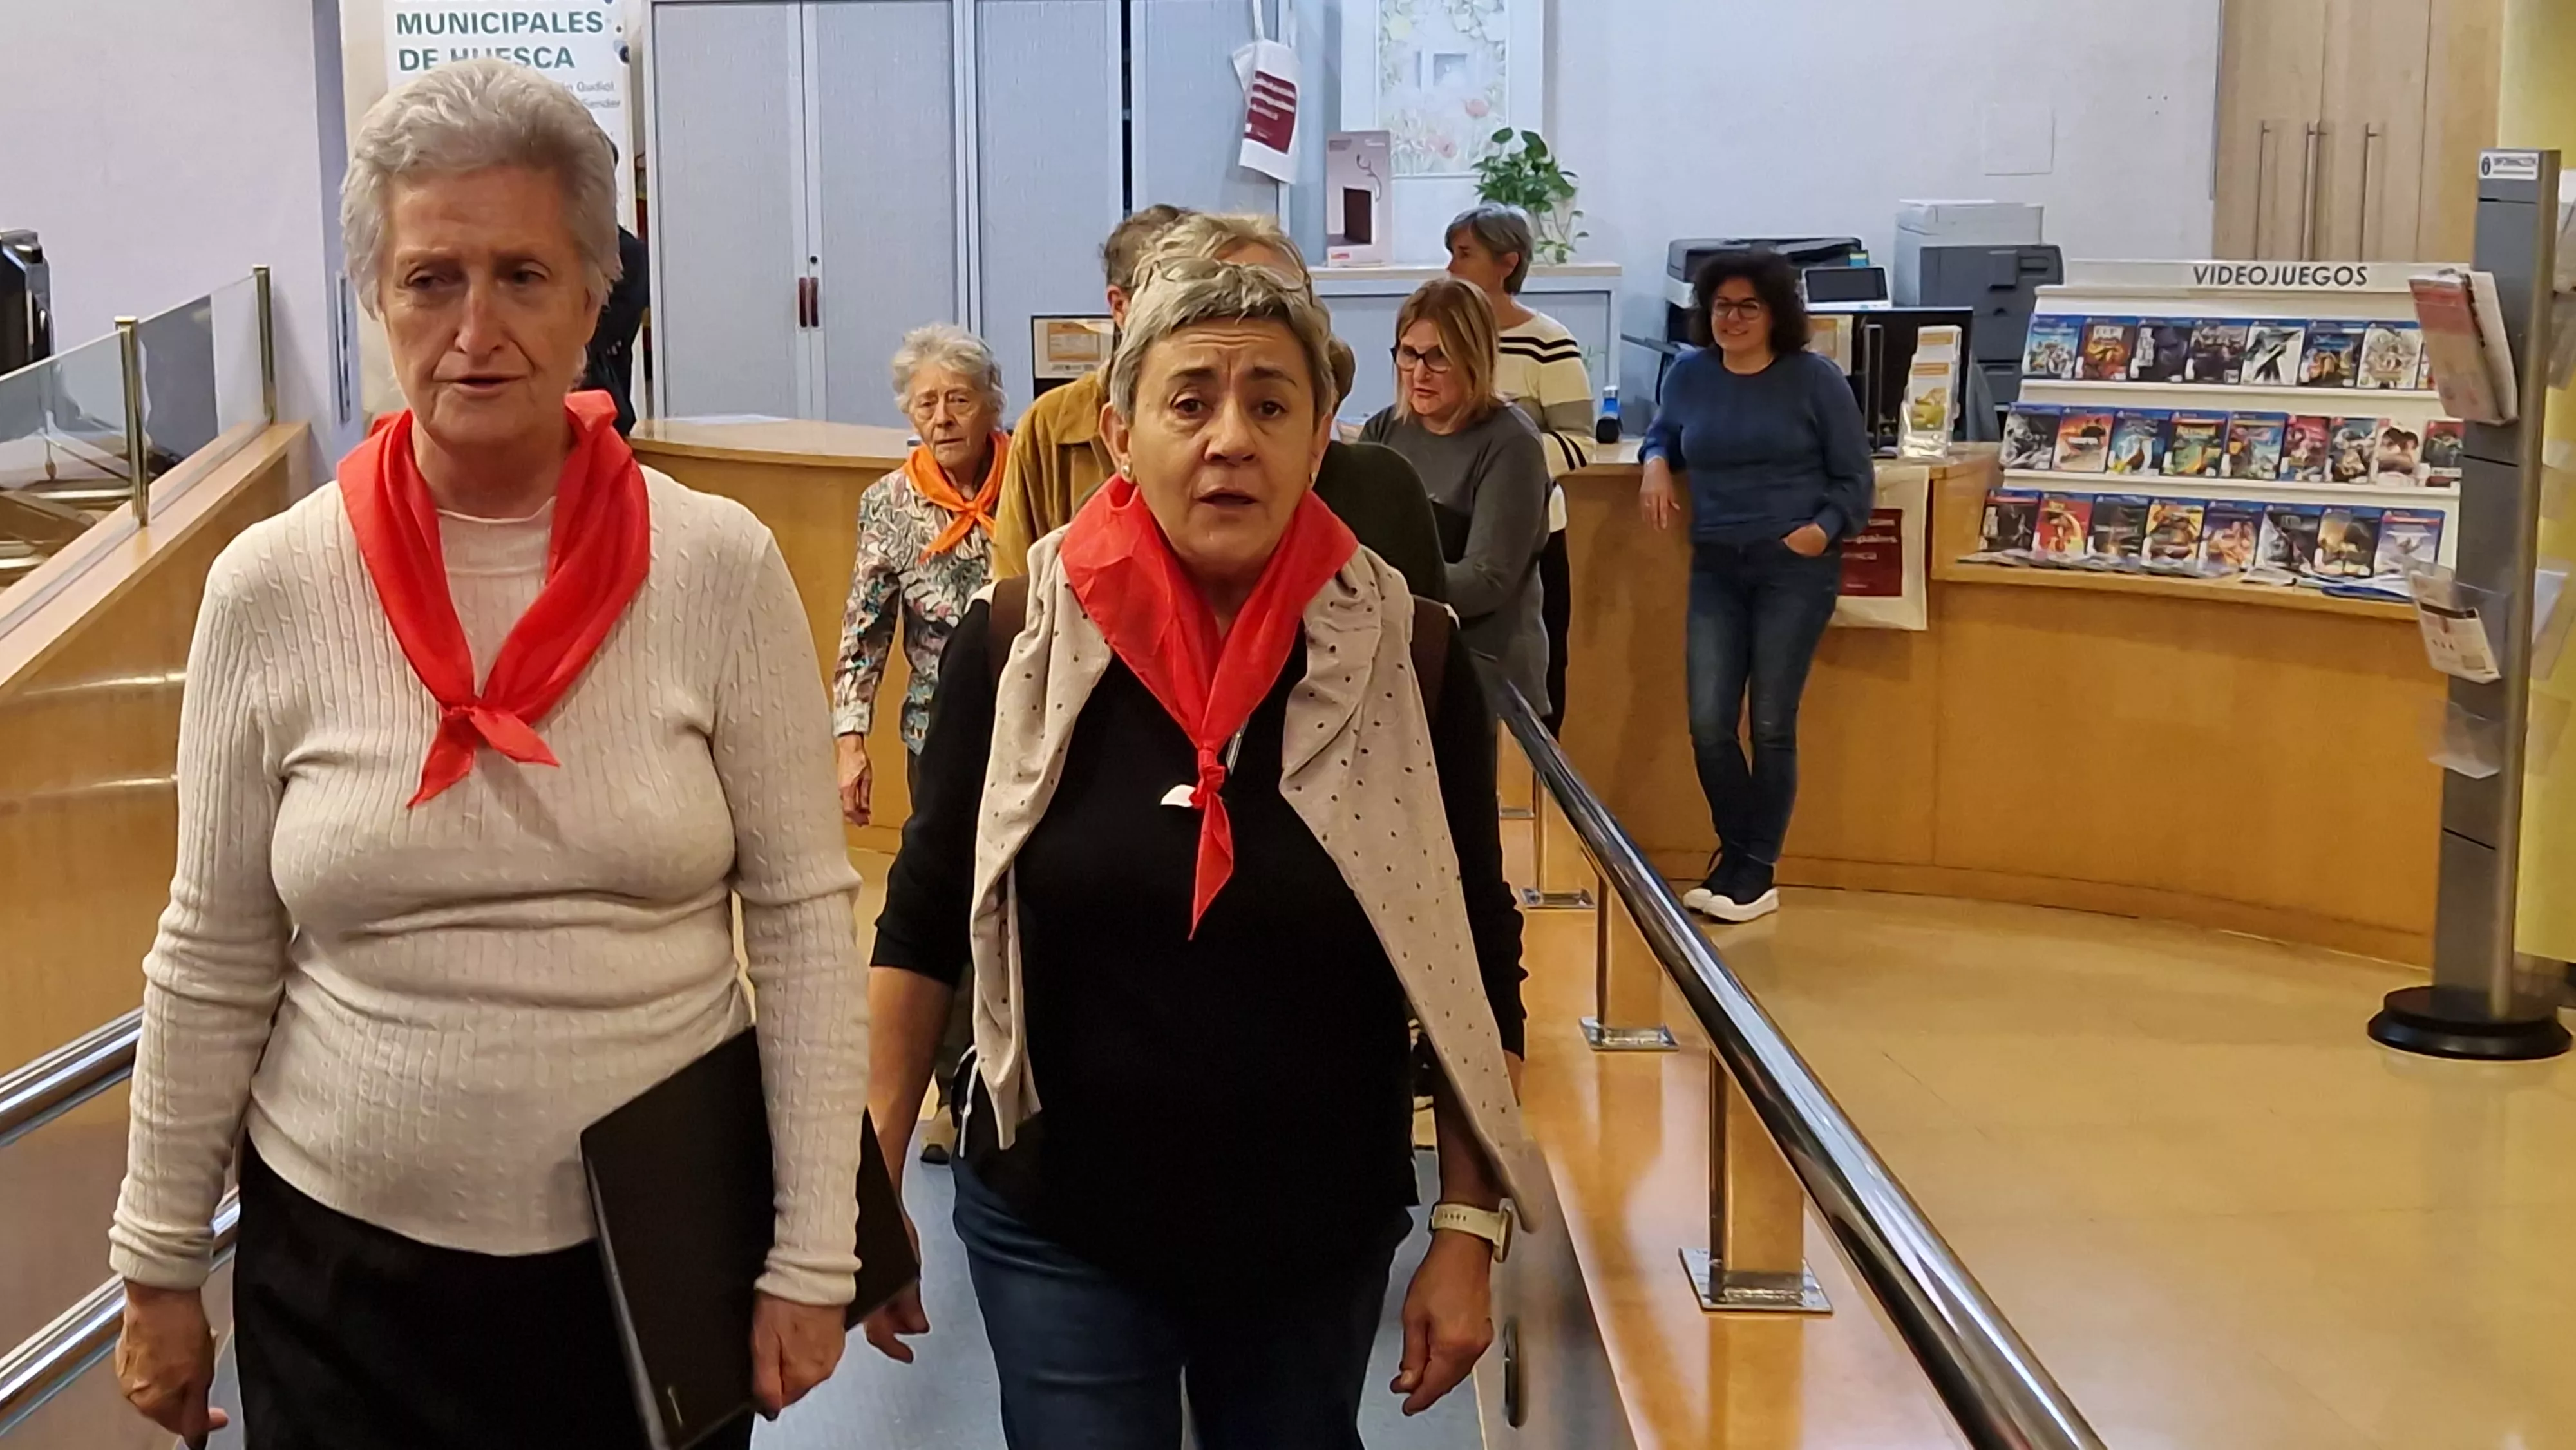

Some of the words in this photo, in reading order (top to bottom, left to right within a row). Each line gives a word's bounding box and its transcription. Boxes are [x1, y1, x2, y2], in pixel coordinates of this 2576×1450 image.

[396, 11, 603, 35] MUNICIPALES
[399, 48, 439, 71] DE
[2193, 266, 2367, 286] VIDEOJUEGOS
